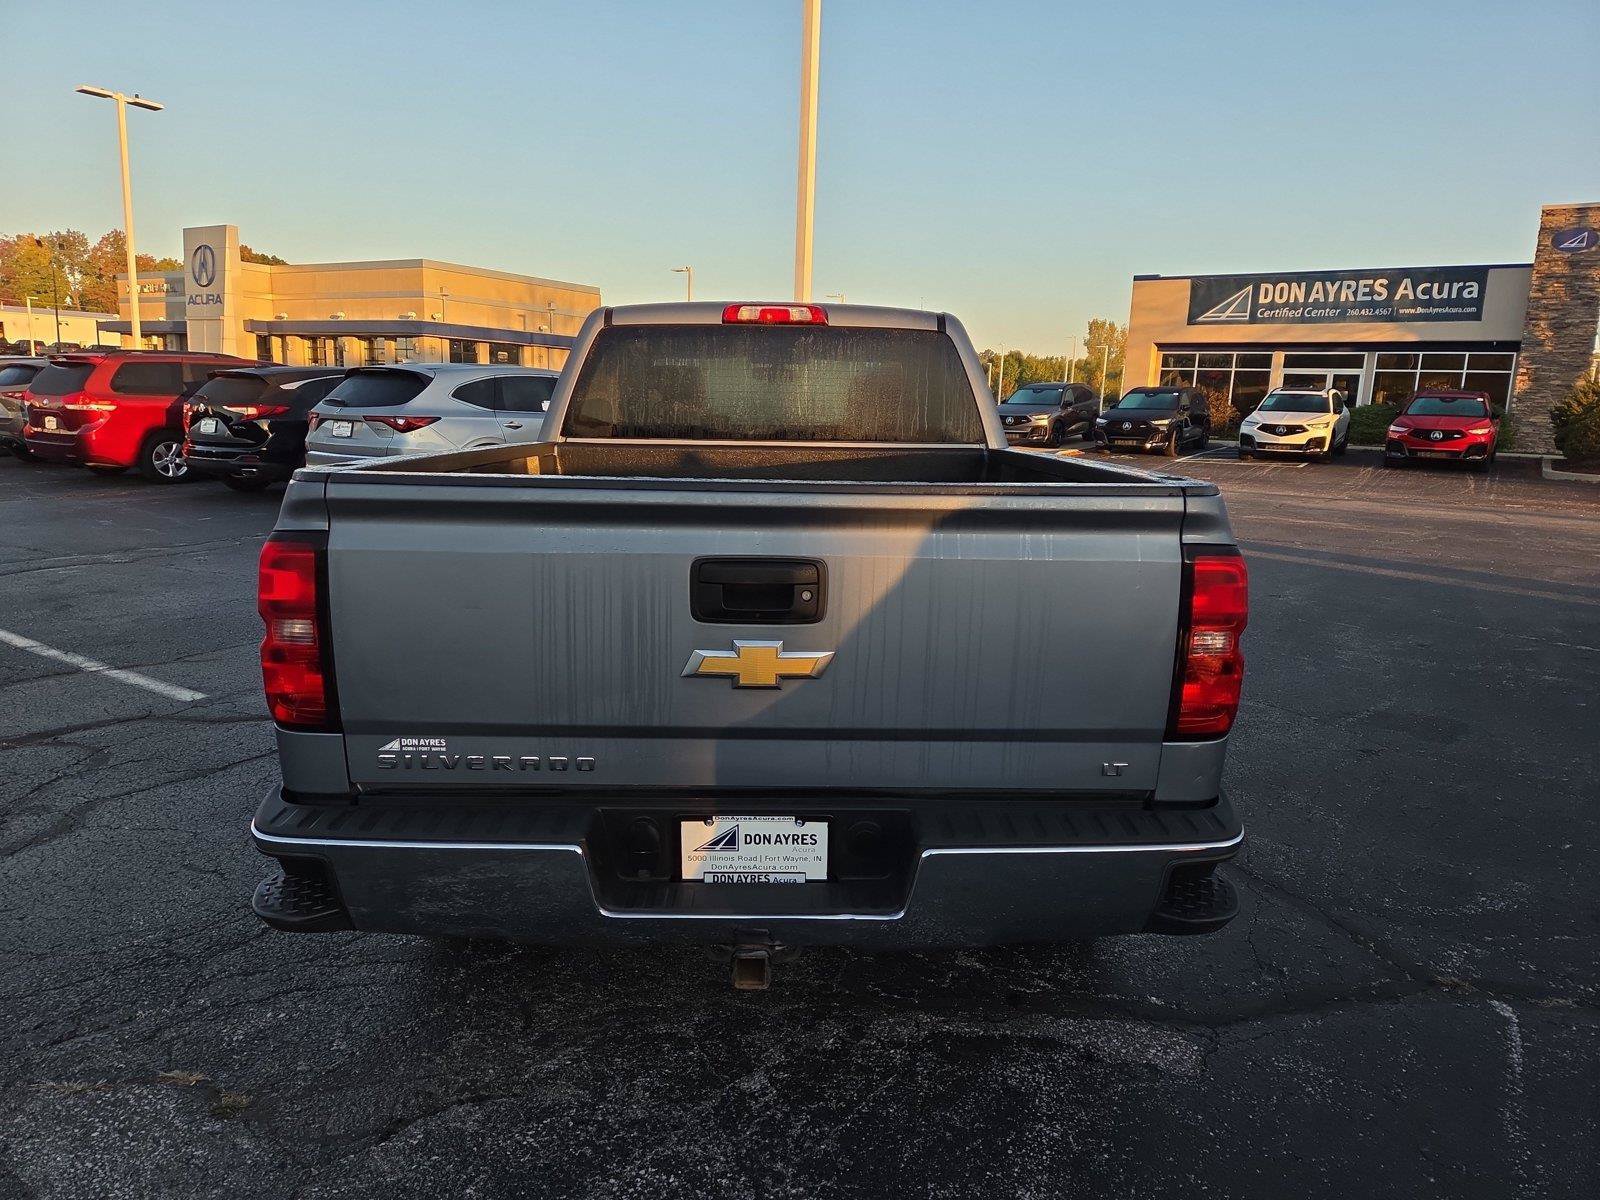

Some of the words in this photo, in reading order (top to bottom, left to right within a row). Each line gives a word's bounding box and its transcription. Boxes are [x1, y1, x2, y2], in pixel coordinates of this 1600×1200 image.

[1258, 281, 1306, 304] DON
[1308, 278, 1389, 303] AYRES
[1394, 277, 1479, 301] Acura
[187, 294, 223, 305] ACURA
[1257, 306, 1303, 318] Certified
[1304, 306, 1341, 318] Center
[1347, 306, 1391, 317] 260.432.4567
[1399, 305, 1477, 316] www.DonAyresAcura.com
[401, 738, 419, 746] DON
[420, 738, 446, 747] AYRES
[378, 754, 596, 772] SILVERADO
[1102, 763, 1129, 777] LT
[744, 833, 771, 846] DON
[774, 833, 818, 846] AYRES
[782, 855, 811, 864] Wayne,
[711, 864, 798, 872] DonAyresAcura.com
[712, 874, 737, 884] DON
[738, 874, 770, 884] AYRES
